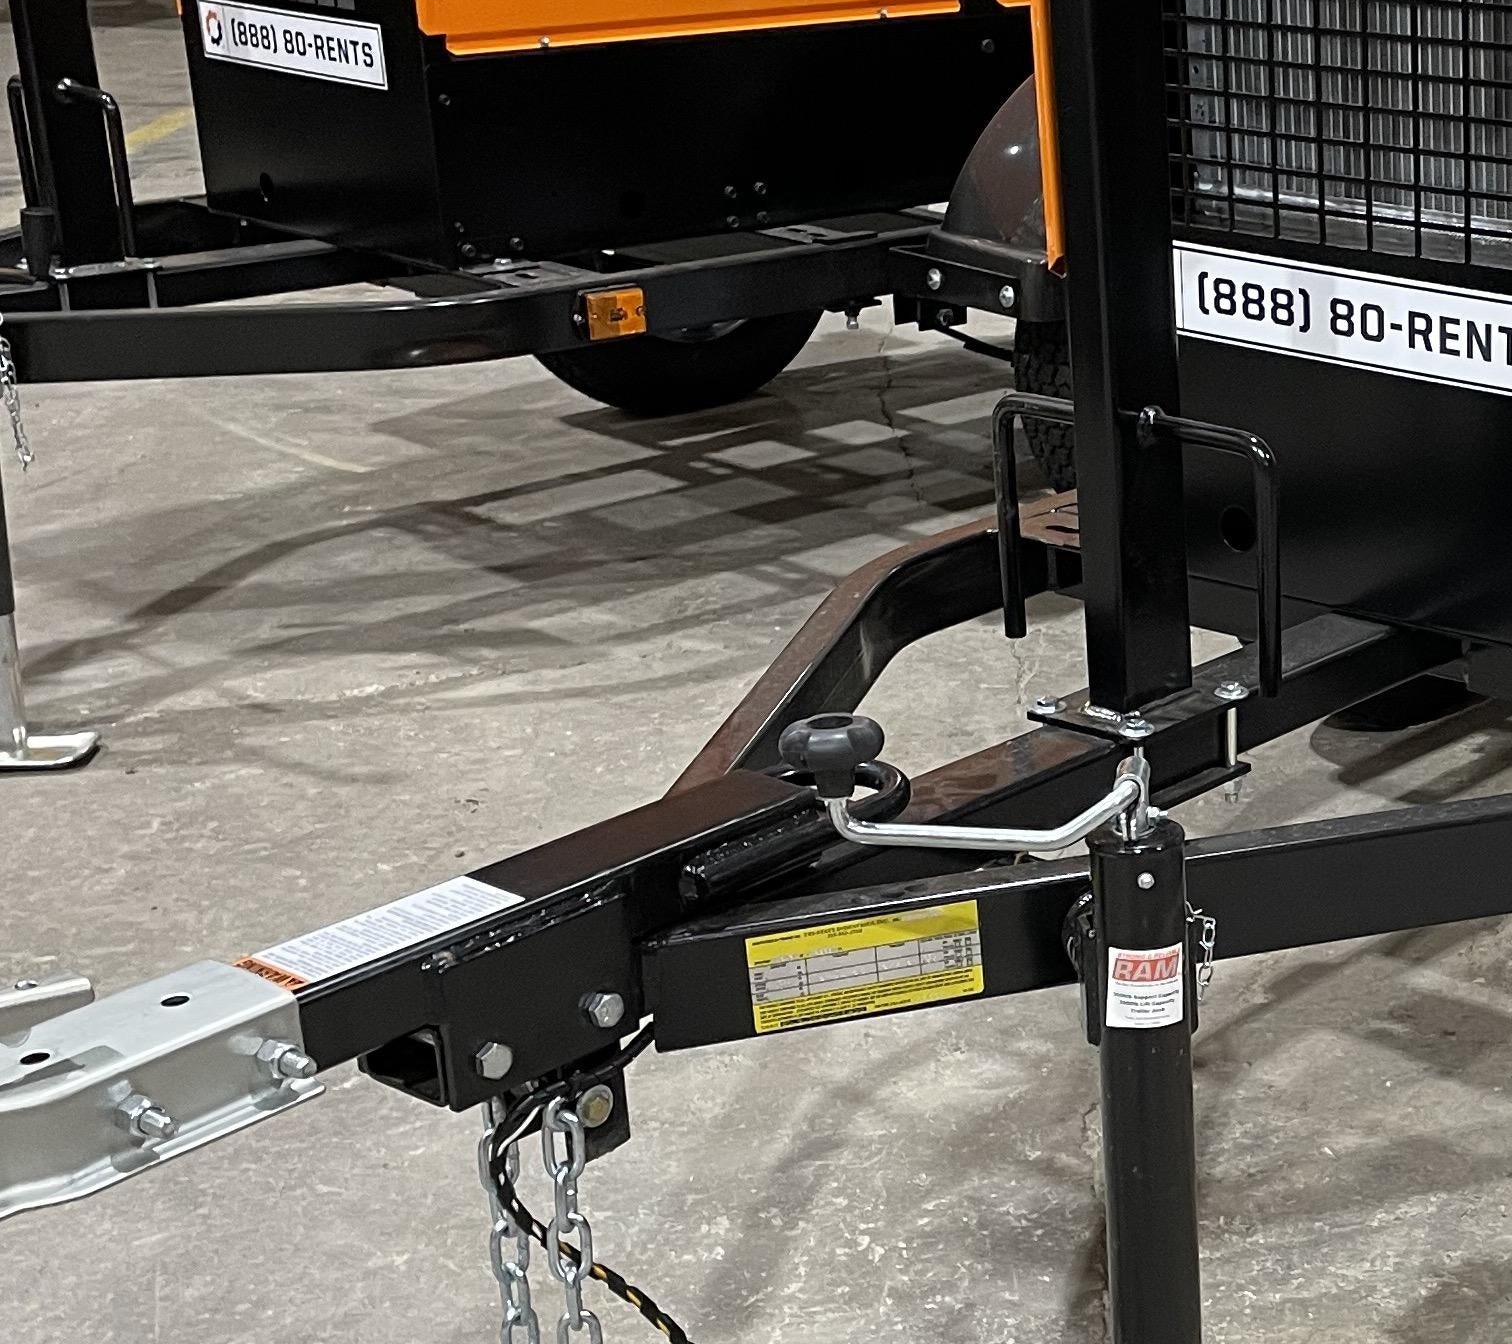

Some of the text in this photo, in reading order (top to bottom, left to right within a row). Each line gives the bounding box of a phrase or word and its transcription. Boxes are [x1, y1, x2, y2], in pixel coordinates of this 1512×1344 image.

[230, 18, 374, 68] (888) 80-RENTS
[1198, 272, 1311, 333] (888)
[1114, 956, 1178, 981] RAM
